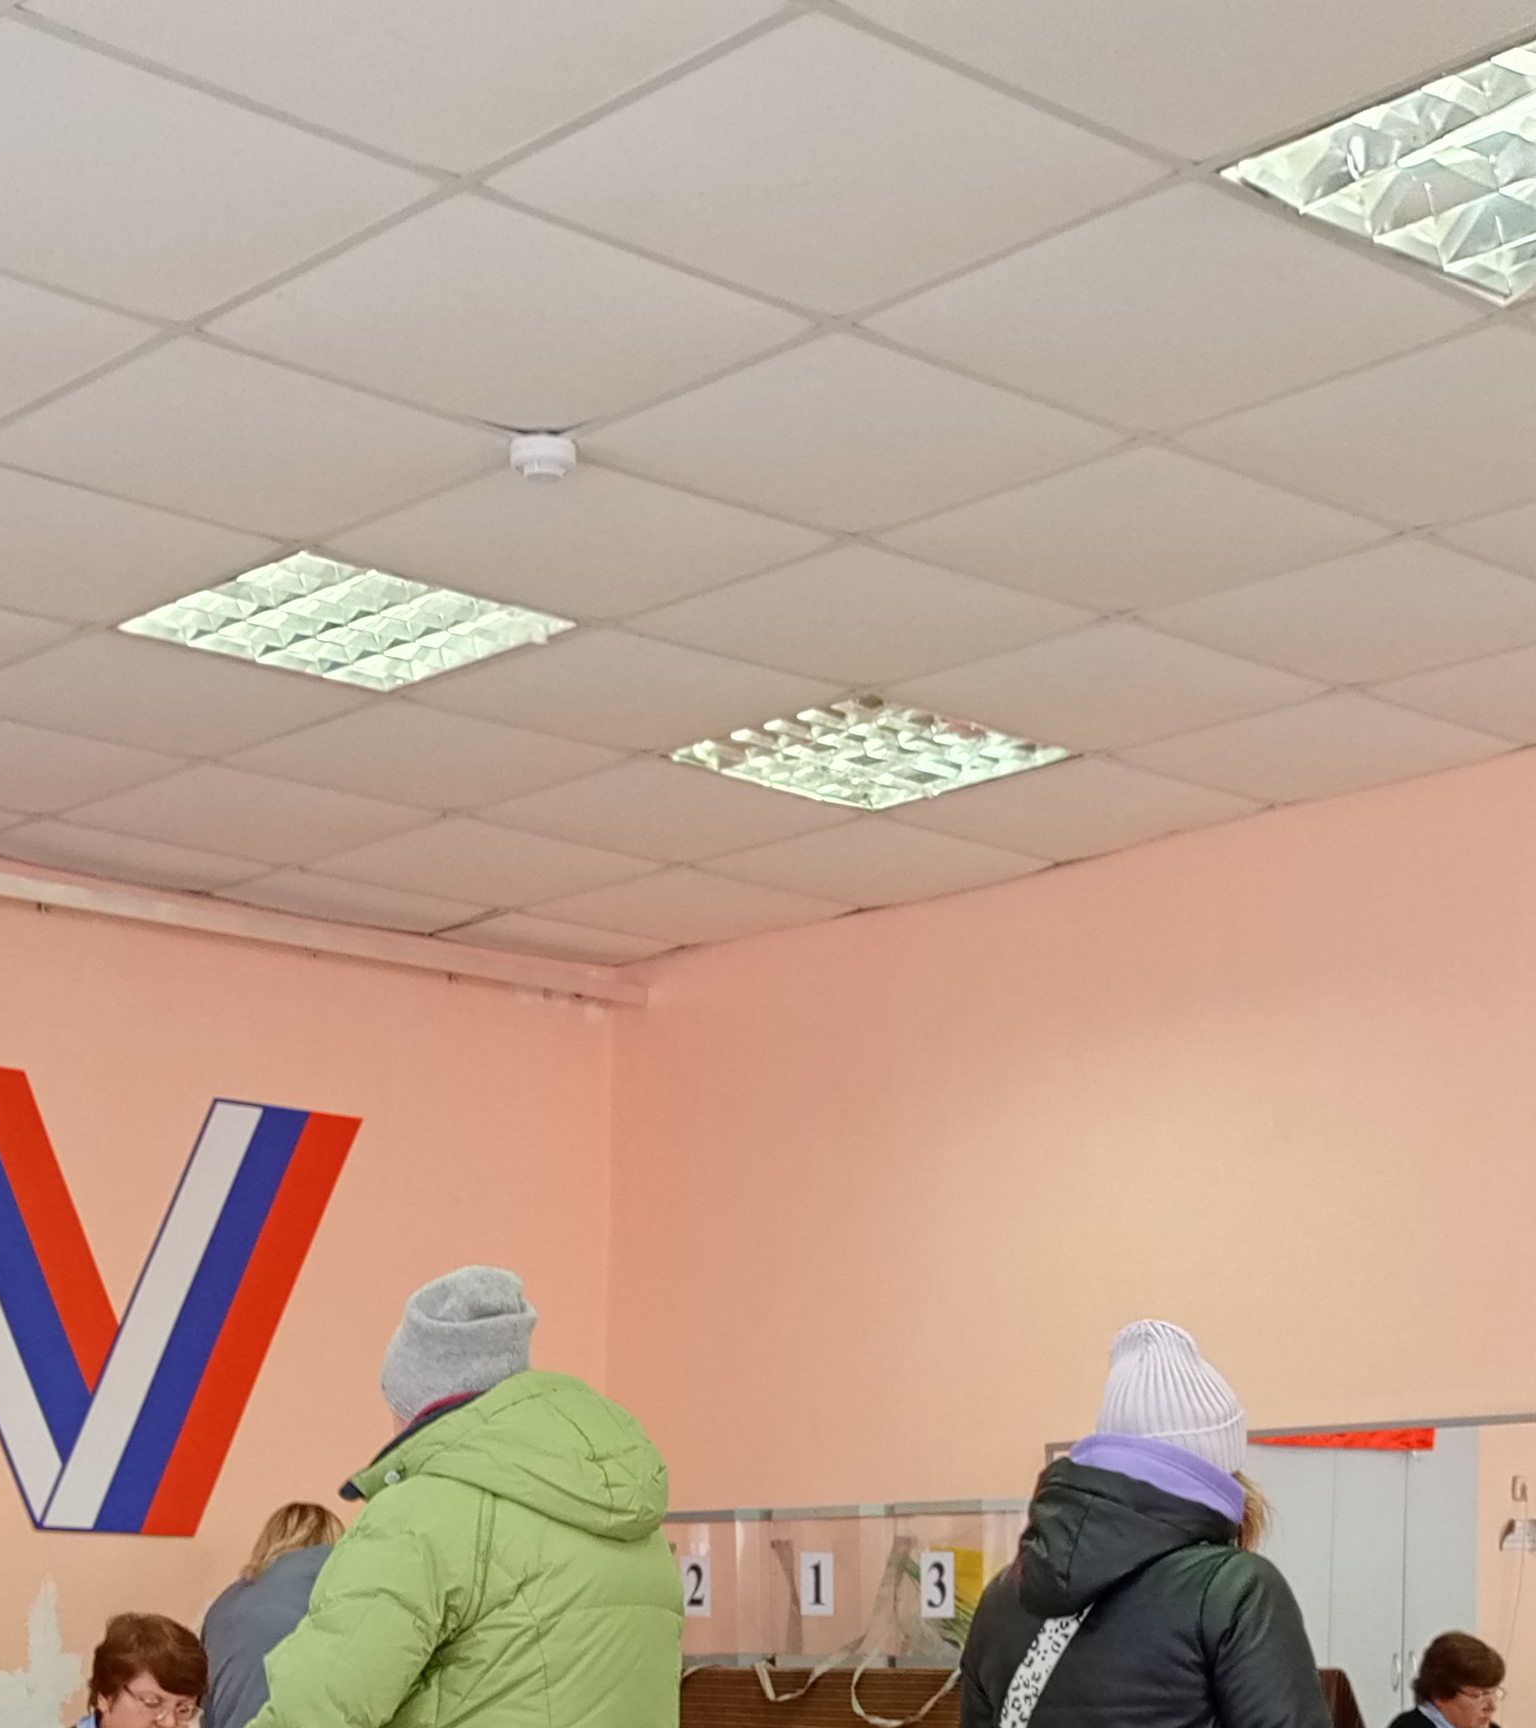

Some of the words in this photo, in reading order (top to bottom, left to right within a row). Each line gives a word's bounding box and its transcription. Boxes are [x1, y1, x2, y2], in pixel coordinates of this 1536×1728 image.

[686, 1563, 705, 1607] 2
[809, 1561, 826, 1606] 1
[926, 1561, 948, 1608] 3
